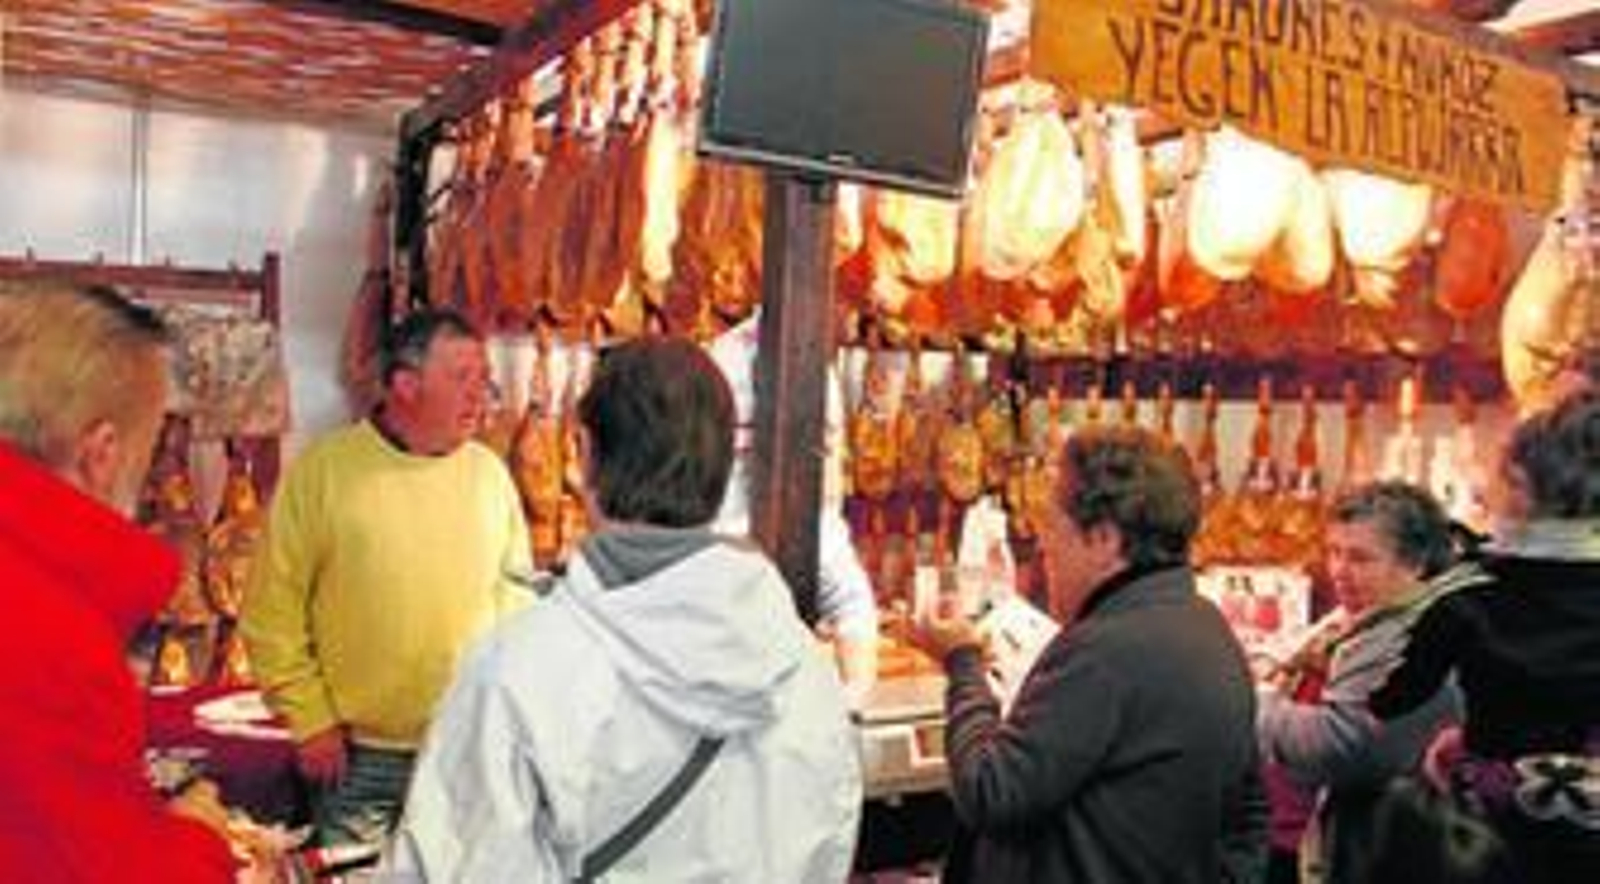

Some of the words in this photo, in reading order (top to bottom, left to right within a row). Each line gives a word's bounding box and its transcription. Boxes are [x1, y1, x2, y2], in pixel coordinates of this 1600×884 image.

[1105, 18, 1279, 130] YEGEN
[1304, 64, 1348, 153] LA
[1157, 0, 1364, 69] MONES
